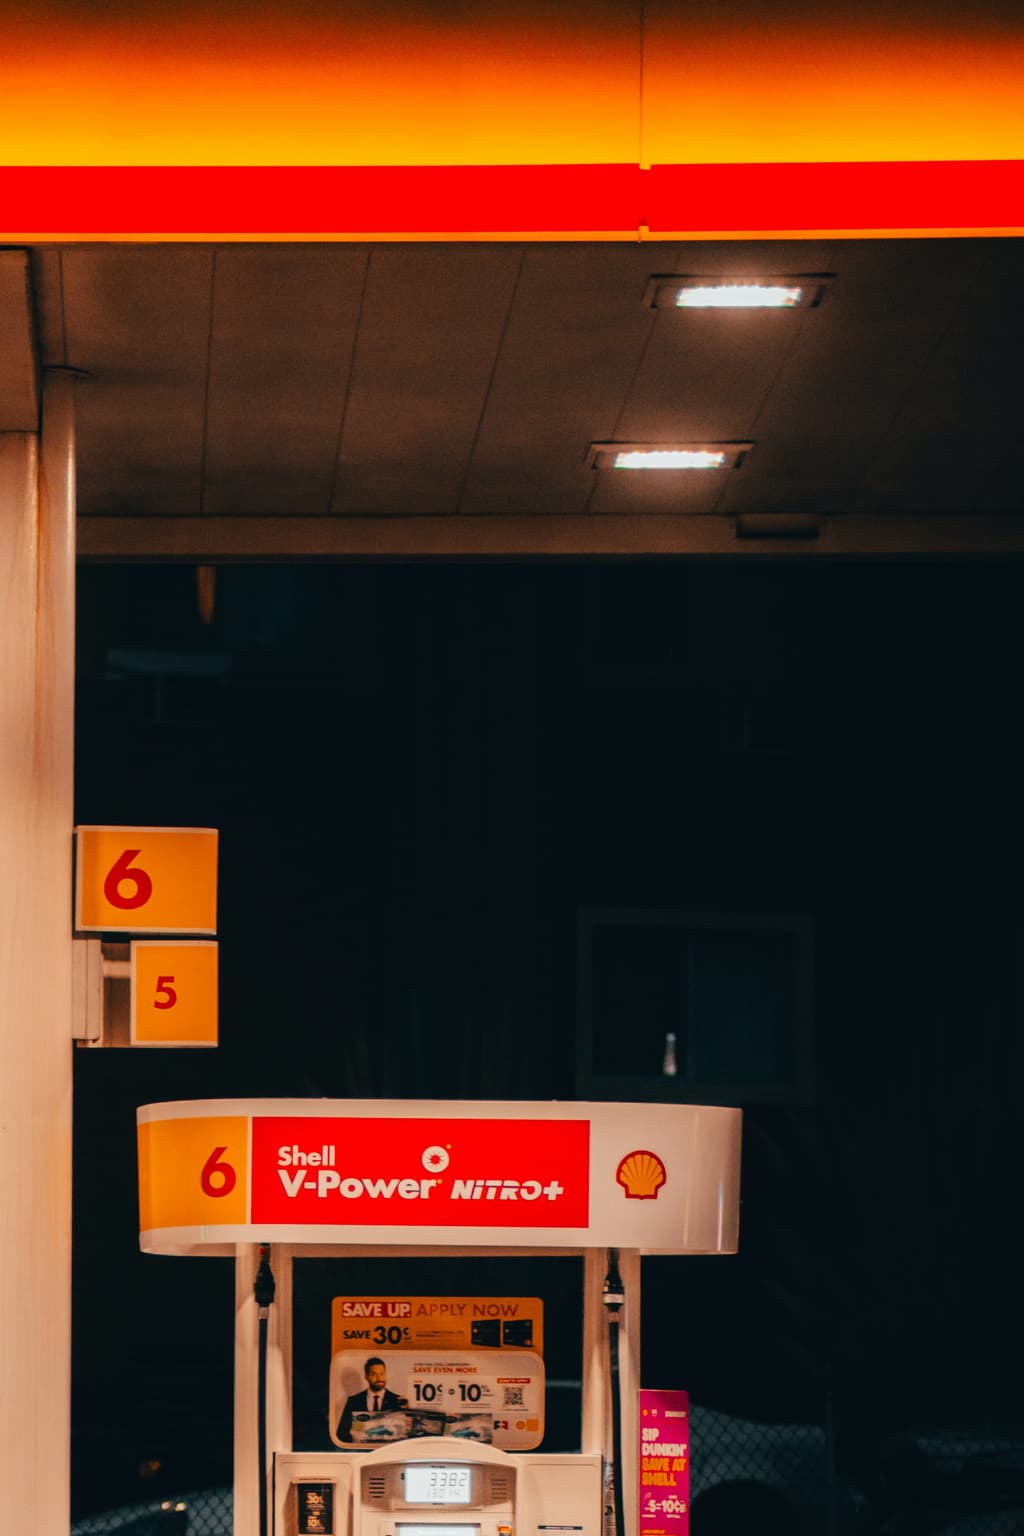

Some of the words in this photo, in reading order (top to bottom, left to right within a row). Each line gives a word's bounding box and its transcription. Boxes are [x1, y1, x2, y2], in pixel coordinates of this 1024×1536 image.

[103, 849, 153, 910] 6
[154, 976, 177, 1010] 5
[277, 1145, 336, 1167] Shell
[200, 1146, 237, 1198] 6
[277, 1169, 437, 1200] V-Power
[342, 1302, 383, 1317] SAVE
[416, 1303, 466, 1317] APPLY
[343, 1330, 371, 1340] SAVE
[642, 1427, 660, 1442] SIP
[642, 1457, 670, 1472] SAVE
[672, 1457, 687, 1472] AT
[642, 1472, 678, 1486] SHELL
